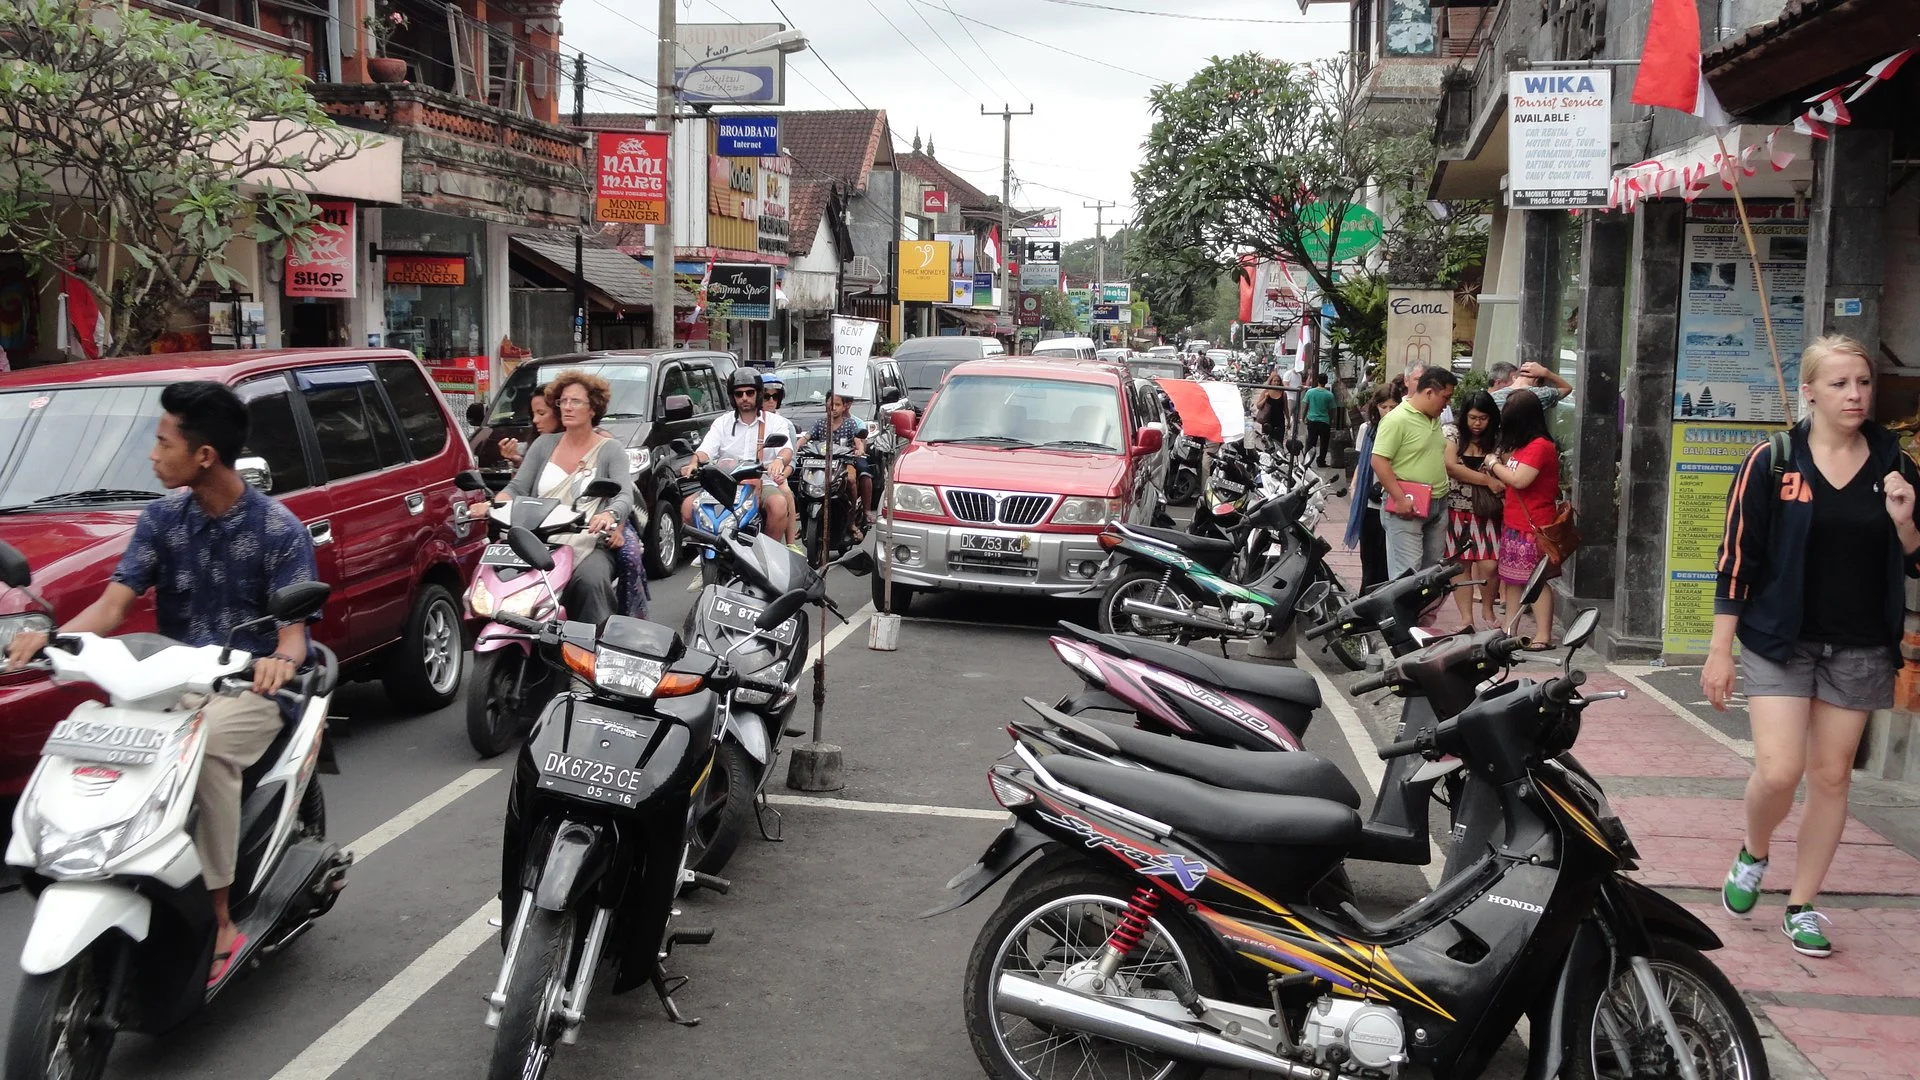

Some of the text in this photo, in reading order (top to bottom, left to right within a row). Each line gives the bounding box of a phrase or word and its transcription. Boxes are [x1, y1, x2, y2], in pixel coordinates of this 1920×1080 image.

[1524, 76, 1595, 93] WIKA
[1513, 96, 1604, 110] Tourist Service
[1514, 113, 1570, 123] AVAILABLE
[720, 125, 777, 137] BROADBAND
[1541, 128, 1569, 136] RENTAL
[733, 140, 762, 149] Internet
[1525, 138, 1551, 147] MOTOR
[602, 155, 662, 175] NANI
[1557, 160, 1592, 169] CYCLING
[730, 161, 753, 193] Kodak
[1525, 171, 1546, 180] DAILY
[609, 199, 653, 210] MONEY
[601, 208, 660, 221] CHANGER
[1783, 226, 1809, 234] TOU
[402, 263, 451, 274] MONEY
[293, 271, 344, 286] SHOP
[392, 272, 459, 283] CHANGER
[731, 272, 747, 285] The
[743, 284, 768, 300] Spa
[840, 326, 865, 336] RENT
[837, 365, 854, 376] BIKE
[1684, 428, 1767, 444] SHUTTLE
[1683, 447, 1703, 455] BALI
[1705, 447, 1728, 456] AREA
[1730, 448, 1737, 456] &
[961, 534, 1023, 552] DK 753 KJ
[486, 546, 501, 556] DK
[716, 600, 733, 616] DK
[1185, 681, 1270, 732] VARIO
[610, 727, 636, 739] HONDA
[544, 752, 642, 791] DK 6725 CE
[587, 785, 603, 798] 05
[618, 793, 632, 804] 16
[1036, 809, 1209, 892] Supra X
[1486, 894, 1545, 914] HONDA
[1221, 933, 1278, 951] ASTREA
